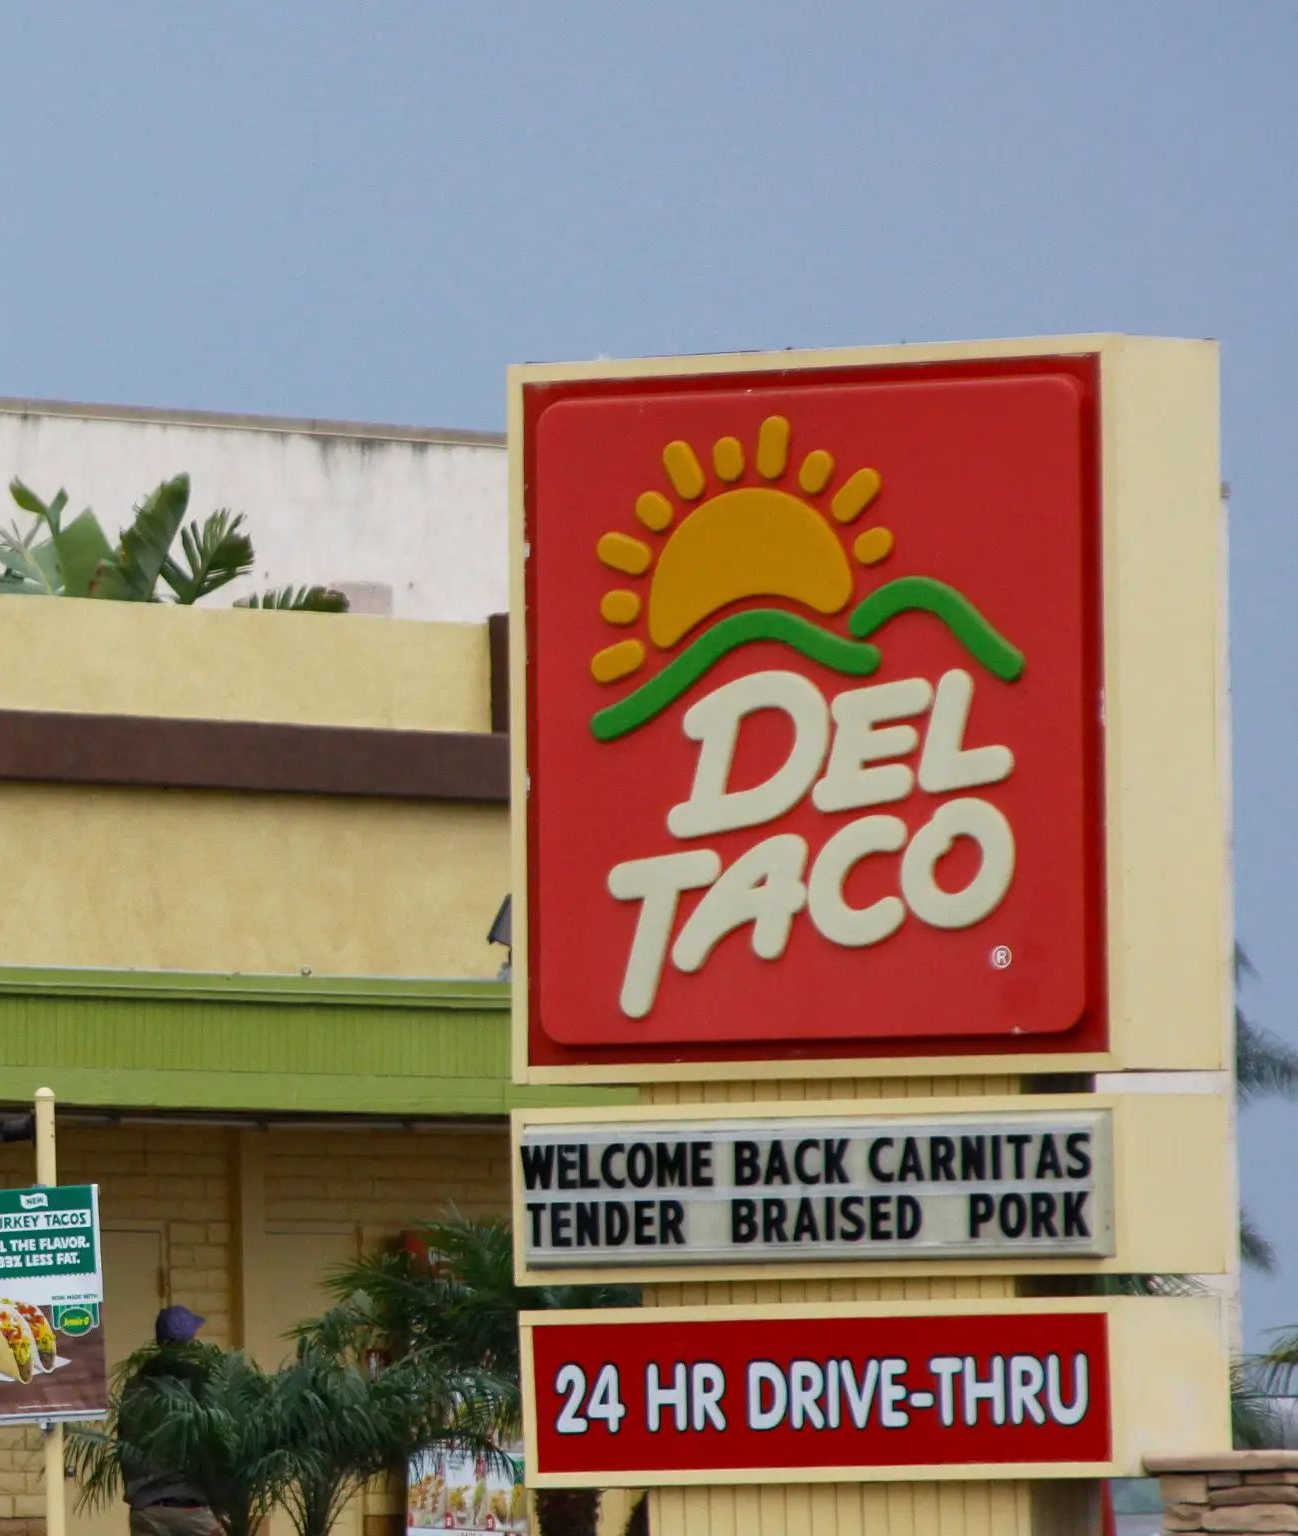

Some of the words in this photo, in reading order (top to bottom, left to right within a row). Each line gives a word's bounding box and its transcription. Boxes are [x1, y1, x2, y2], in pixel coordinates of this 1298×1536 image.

[667, 669, 1014, 838] DEL
[608, 797, 1015, 1018] TACO
[521, 1141, 714, 1190] WELCOME
[733, 1136, 850, 1186] BACK
[868, 1133, 1092, 1182] CARNITAS
[26, 1197, 44, 1206] NEW
[44, 1212, 86, 1226] TACOS
[527, 1200, 686, 1247] TENDER
[731, 1195, 922, 1243] BRAISED
[969, 1191, 1091, 1238] PORK
[10, 1239, 36, 1252] THE
[39, 1236, 90, 1250] FLAVOR.
[25, 1253, 53, 1267] LESS
[56, 1252, 81, 1265] FAT.
[555, 1362, 625, 1434] 24
[646, 1361, 727, 1433] HR
[746, 1352, 1089, 1431] DRIVE-THRU
